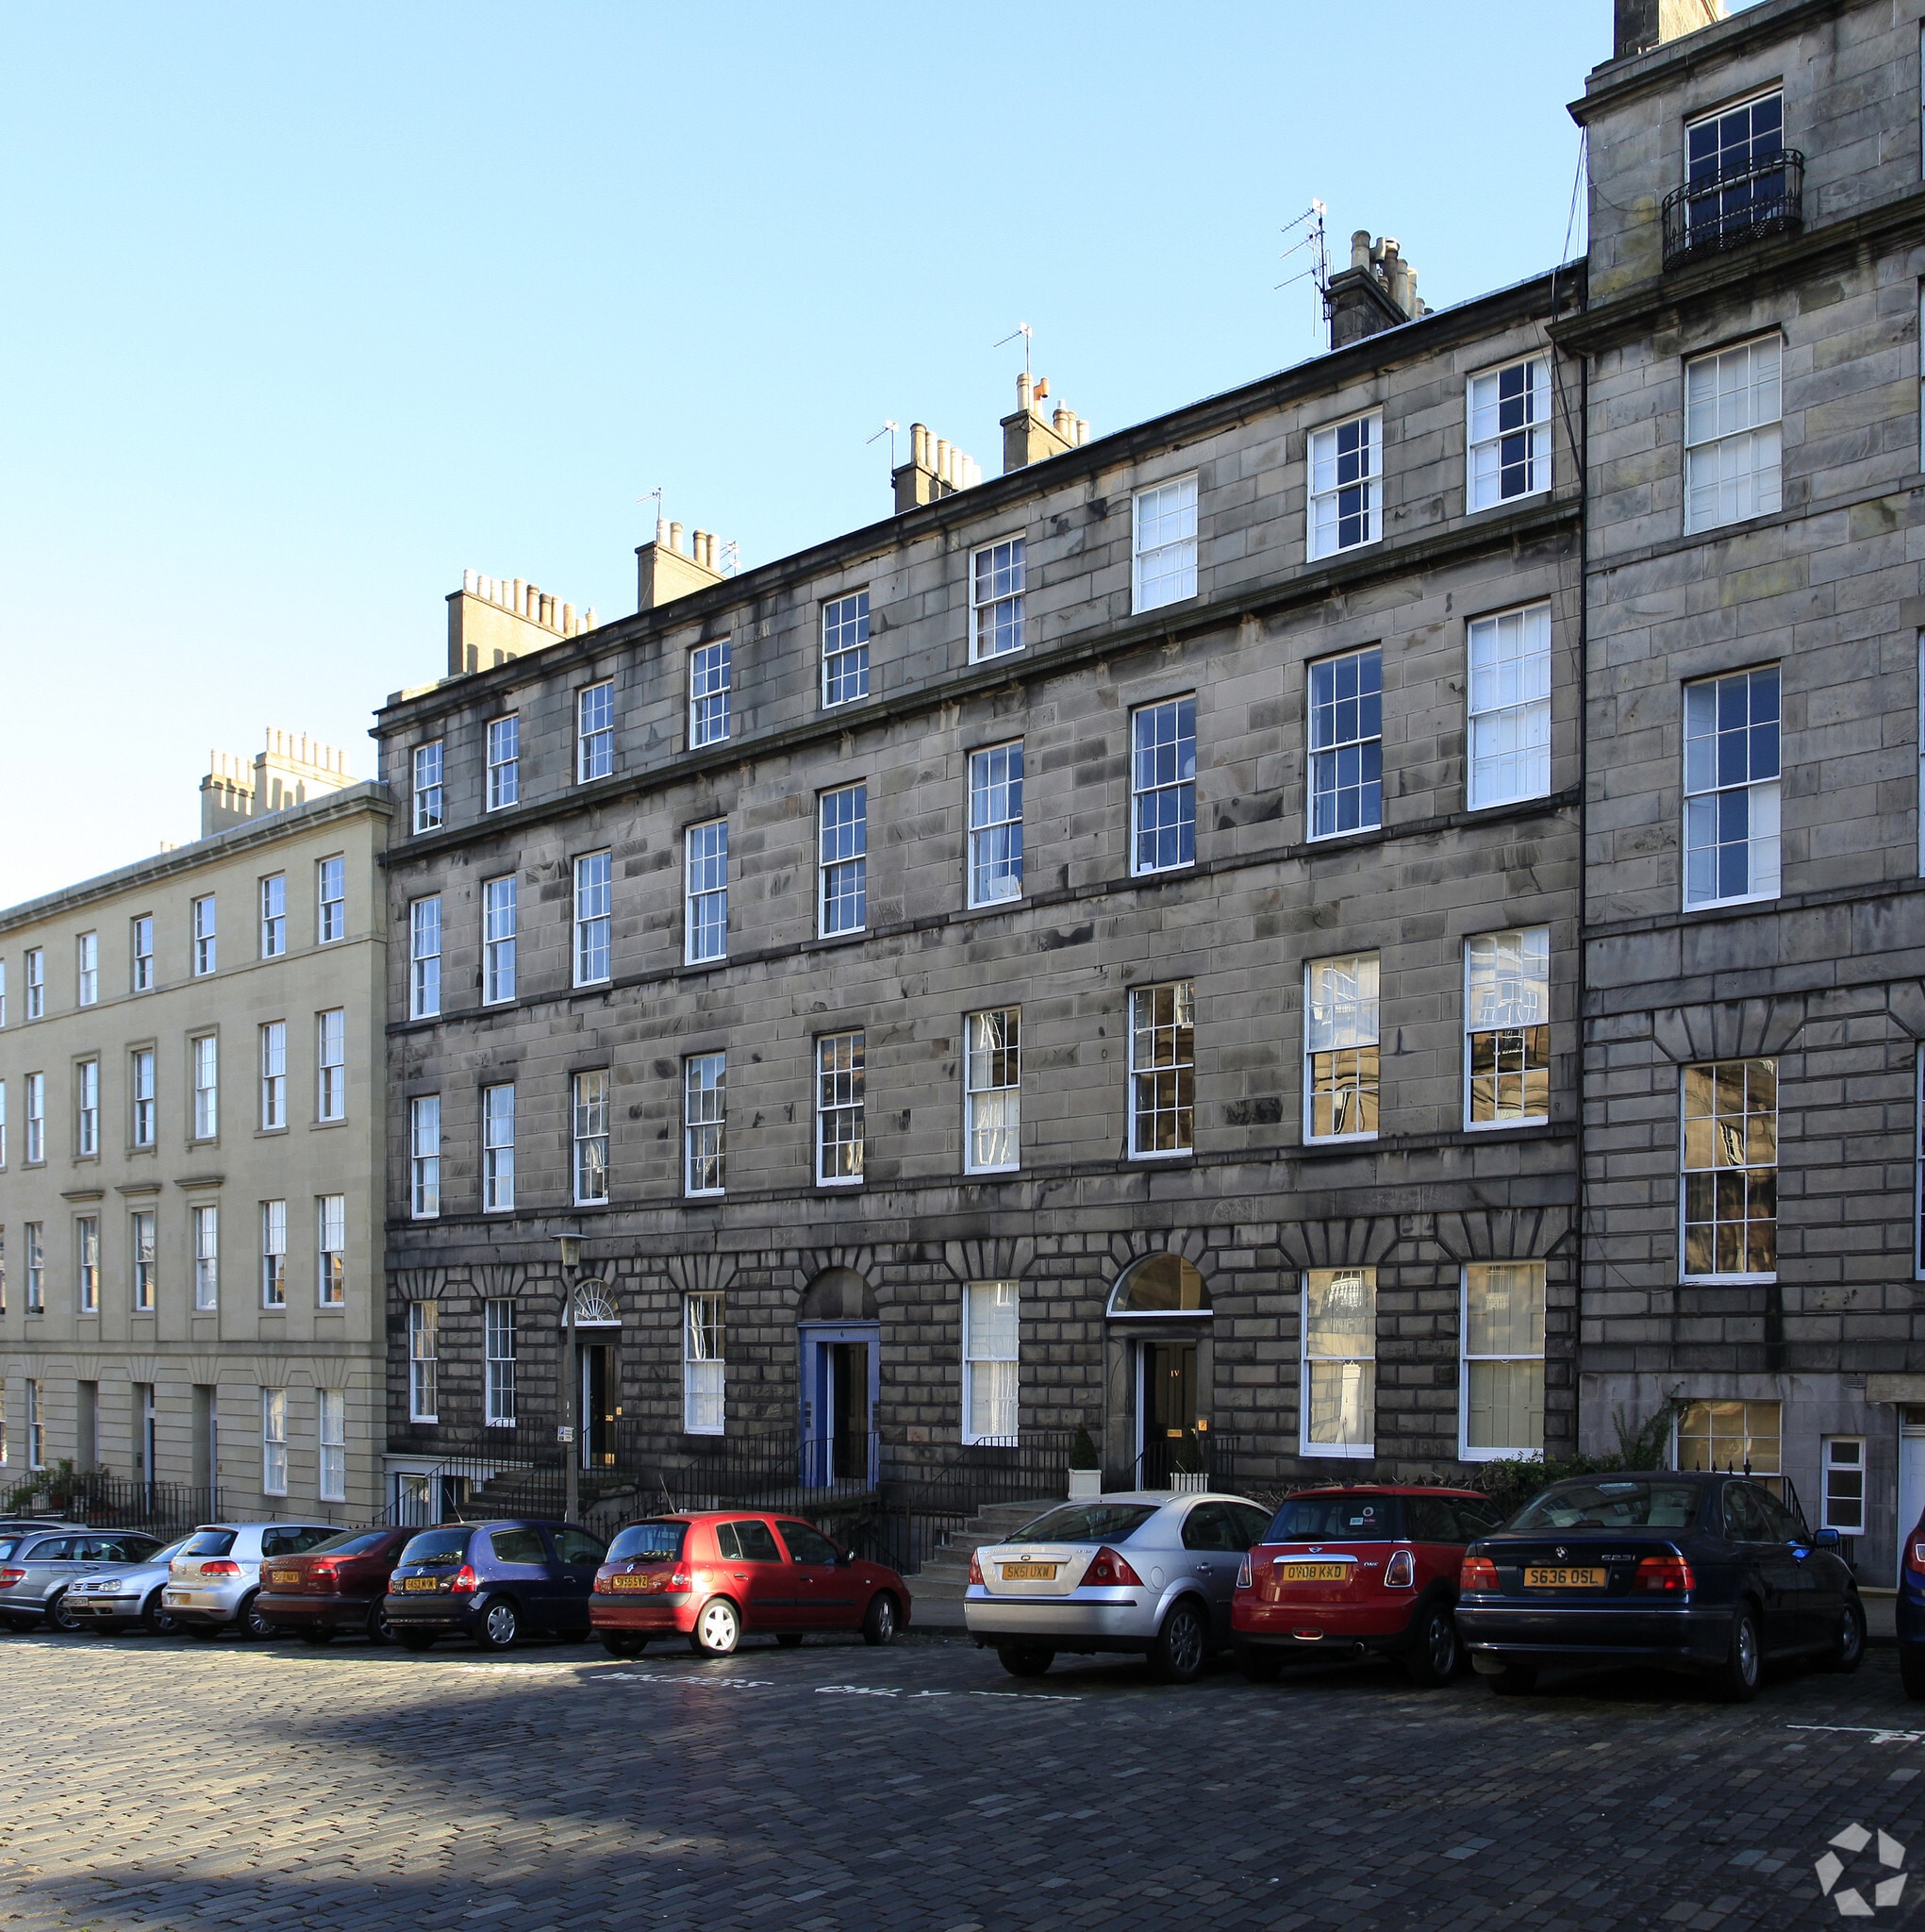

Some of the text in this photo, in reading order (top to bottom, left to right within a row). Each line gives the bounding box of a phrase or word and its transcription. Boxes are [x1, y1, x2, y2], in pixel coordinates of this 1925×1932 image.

[1007, 1565, 1050, 1577] SK51 UXW
[1287, 1566, 1341, 1578] OY08 KXD
[1530, 1569, 1597, 1584] S636 OSL
[633, 1576, 647, 1587] SYZ
